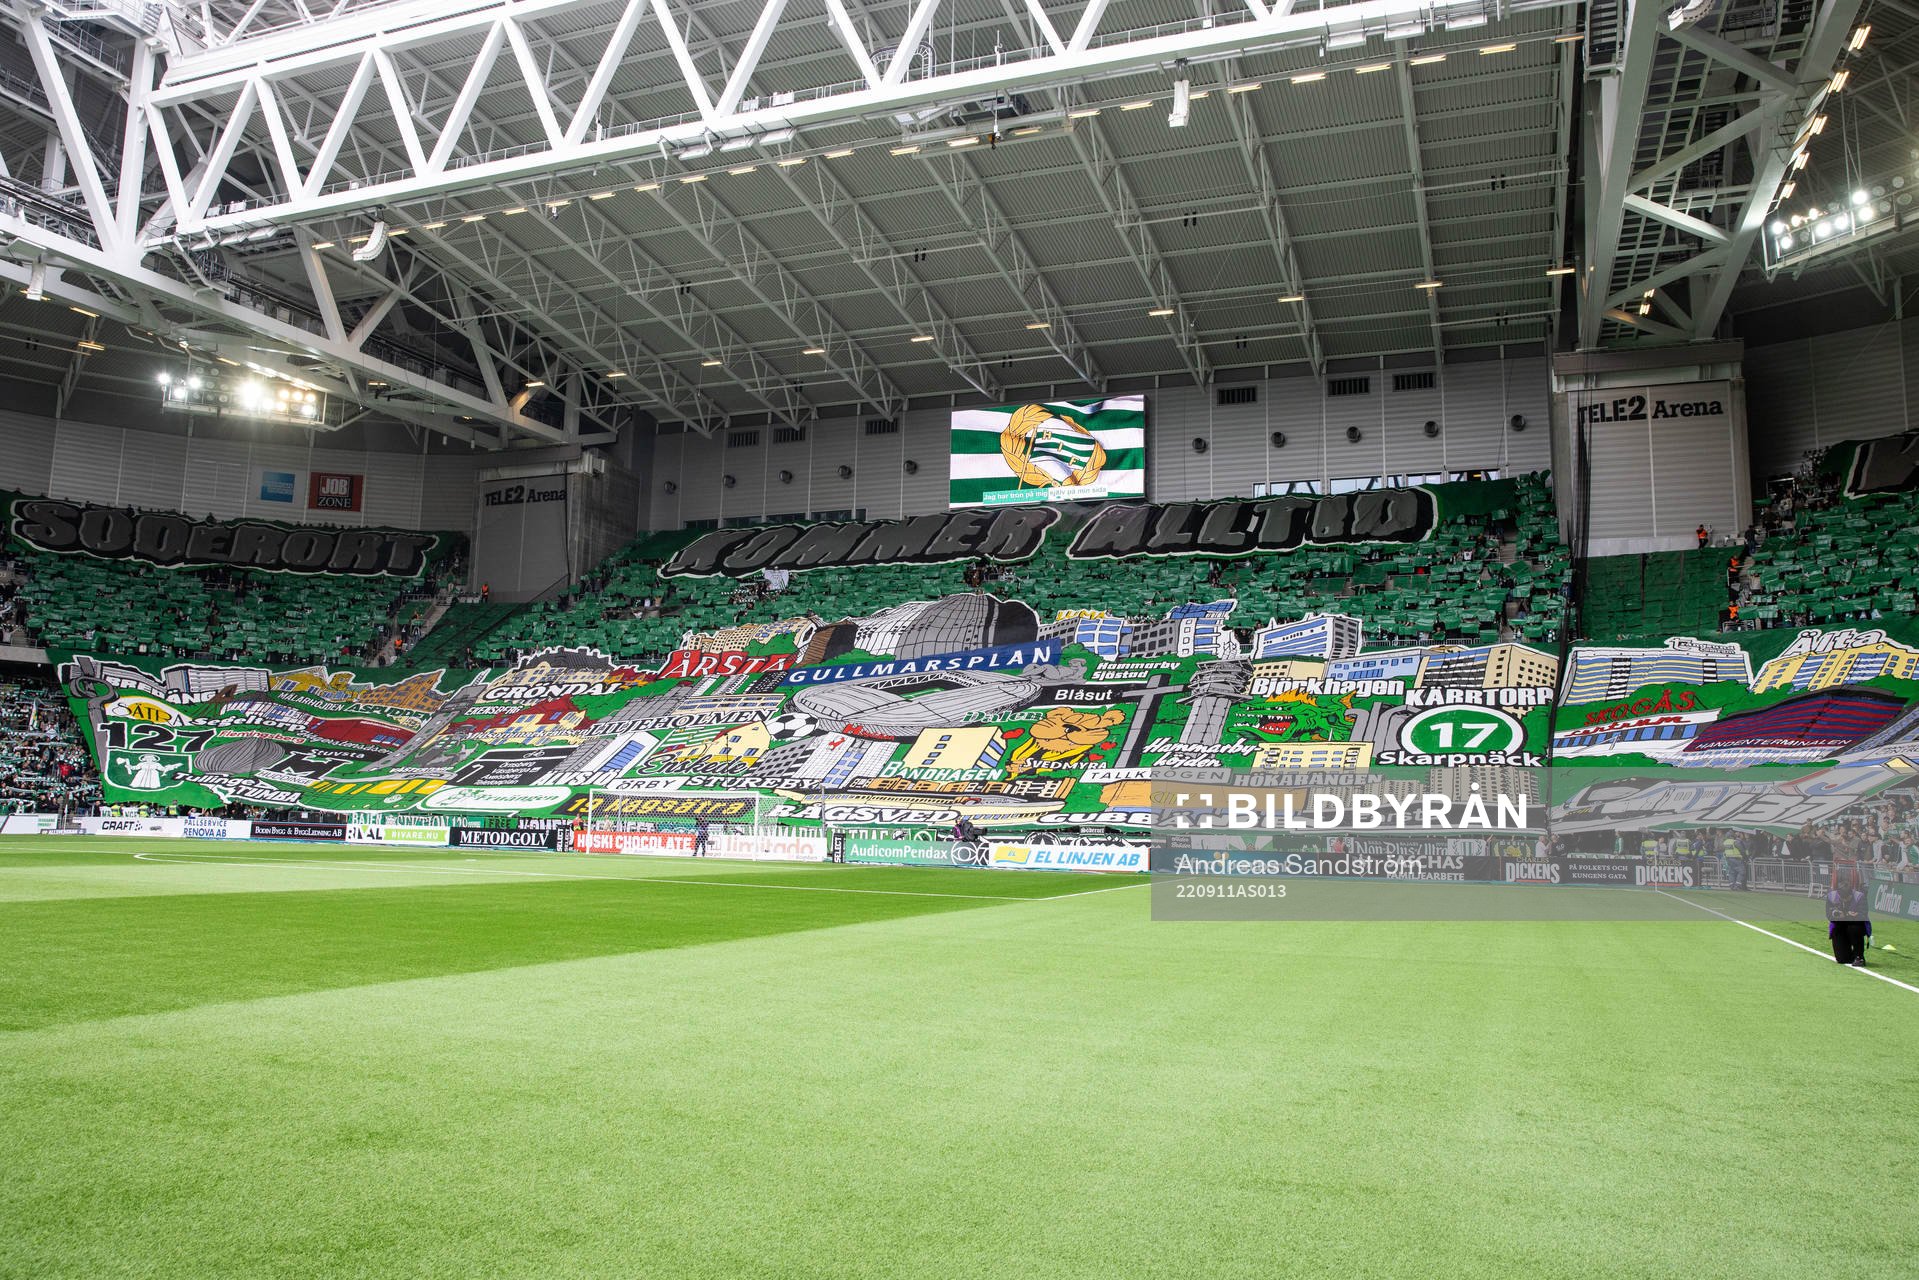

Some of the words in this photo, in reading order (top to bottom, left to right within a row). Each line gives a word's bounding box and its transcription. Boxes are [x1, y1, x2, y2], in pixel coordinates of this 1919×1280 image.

[1579, 395, 1647, 424] TELE2
[1652, 400, 1723, 419] Arena
[321, 477, 350, 496] JOB
[1025, 491, 1034, 499] på
[318, 496, 351, 508] ZONE
[485, 485, 525, 506] TELE2
[526, 488, 567, 503] Arena
[668, 507, 1050, 572] KOMMER
[1078, 488, 1420, 551] ALLTID
[1057, 609, 1105, 620] LUMA
[1780, 629, 1882, 658] Älta
[661, 650, 787, 679] ÅRSTA
[789, 645, 1051, 683] GULLMARSPLAN
[1096, 661, 1181, 671] Hammarby
[1091, 670, 1149, 681] Sjöstad
[104, 675, 218, 705] BREDÄNG
[484, 682, 621, 700] GRÖNDAL
[1054, 689, 1112, 701] Blåsut
[1251, 677, 1404, 697] Björkhagen
[1405, 687, 1553, 706] KÄRRTORP
[112, 701, 186, 727] SÄTRA
[345, 703, 433, 722] ASPUDDEN
[1584, 689, 1696, 726] SKOGÅS
[193, 715, 307, 732] Segeltorp
[585, 708, 776, 736] LILJEHOLMEN
[963, 710, 1047, 723] Dalen
[98, 721, 217, 753] 127
[217, 730, 306, 743] Flemingsberg
[1430, 722, 1499, 748] 17
[1694, 738, 1852, 750] HANDENTERMINALEN
[311, 748, 366, 759] Stuvsta
[1153, 752, 1222, 768] höjden
[1379, 750, 1543, 767] Skarpnäck
[638, 754, 750, 775] Enskede
[174, 772, 257, 787] Tullinge
[616, 778, 677, 790] ÖRBY
[685, 776, 816, 790] STUREBY
[1233, 769, 1384, 786] HÖKARÄNGEN
[236, 785, 302, 803] TUMBA
[604, 795, 746, 816] Hagsätra
[765, 803, 961, 823] RÅGSVED
[102, 821, 135, 831] CRAFT
[184, 819, 227, 828] PALLSERVICE
[488, 818, 511, 828] FREE
[184, 828, 215, 838] RENOVA
[216, 829, 227, 838] AB
[333, 829, 343, 838] AB
[459, 829, 550, 846] METODGOLV
[577, 834, 613, 850] HUSKI
[615, 835, 693, 851] CHOCOLATE
[851, 843, 948, 859] AudicomPendax
[1034, 851, 1053, 864] EL
[1057, 852, 1116, 867] LINJEN
[1118, 853, 1141, 867] AB
[1505, 863, 1561, 884] DICKENS
[1578, 864, 1610, 872] FOLKETS
[1635, 865, 1694, 887] DICKENS
[1874, 883, 1903, 914] Clinton
